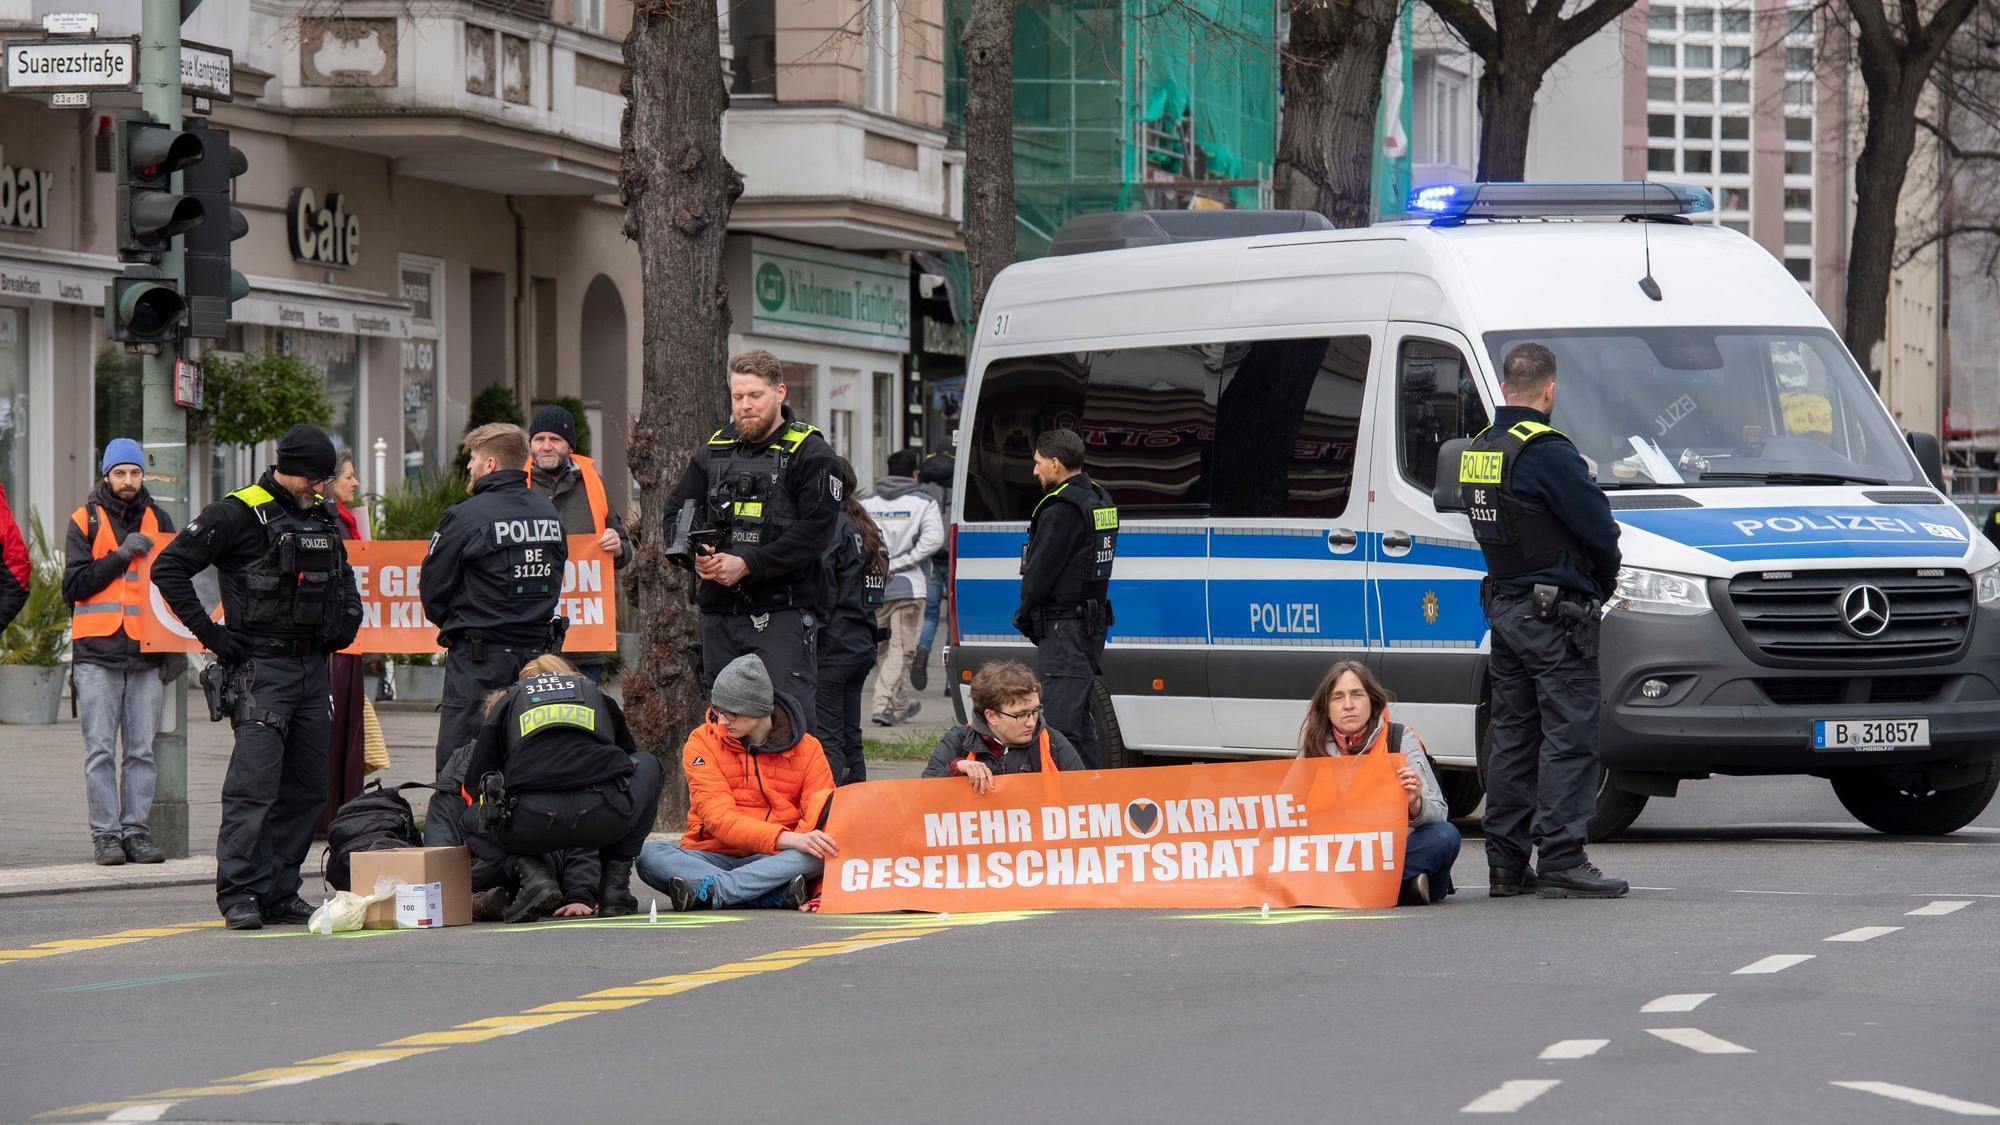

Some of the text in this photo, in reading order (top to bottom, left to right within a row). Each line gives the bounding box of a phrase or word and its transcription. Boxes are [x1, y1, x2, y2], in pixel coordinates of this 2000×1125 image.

[18, 49, 124, 77] Suarezstraße
[181, 59, 193, 77] eue
[1, 273, 84, 301] Breakfast Lunch
[789, 268, 853, 320] Kindermann
[994, 314, 1010, 337] 31
[1462, 454, 1501, 481] POLIZEI
[1474, 489, 1487, 505] BE
[1470, 507, 1497, 521] 31117
[494, 519, 562, 545] POLIZEI
[732, 531, 760, 543] POLIZEI
[1732, 515, 1917, 537] POLIZEI
[301, 537, 329, 548] POLIZEI
[1104, 536, 1111, 549] BE
[525, 549, 543, 563] BE
[514, 563, 551, 578] 31126
[1250, 602, 1321, 633] POLIZEI
[525, 681, 575, 695] 31115
[538, 676, 560, 684] BE
[522, 704, 593, 733] POLIZEI
[1836, 722, 1919, 744] B 31857
[924, 809, 1033, 848] MEHR
[840, 831, 1396, 892] GESELLSCHAFTSRAT JETZT!
